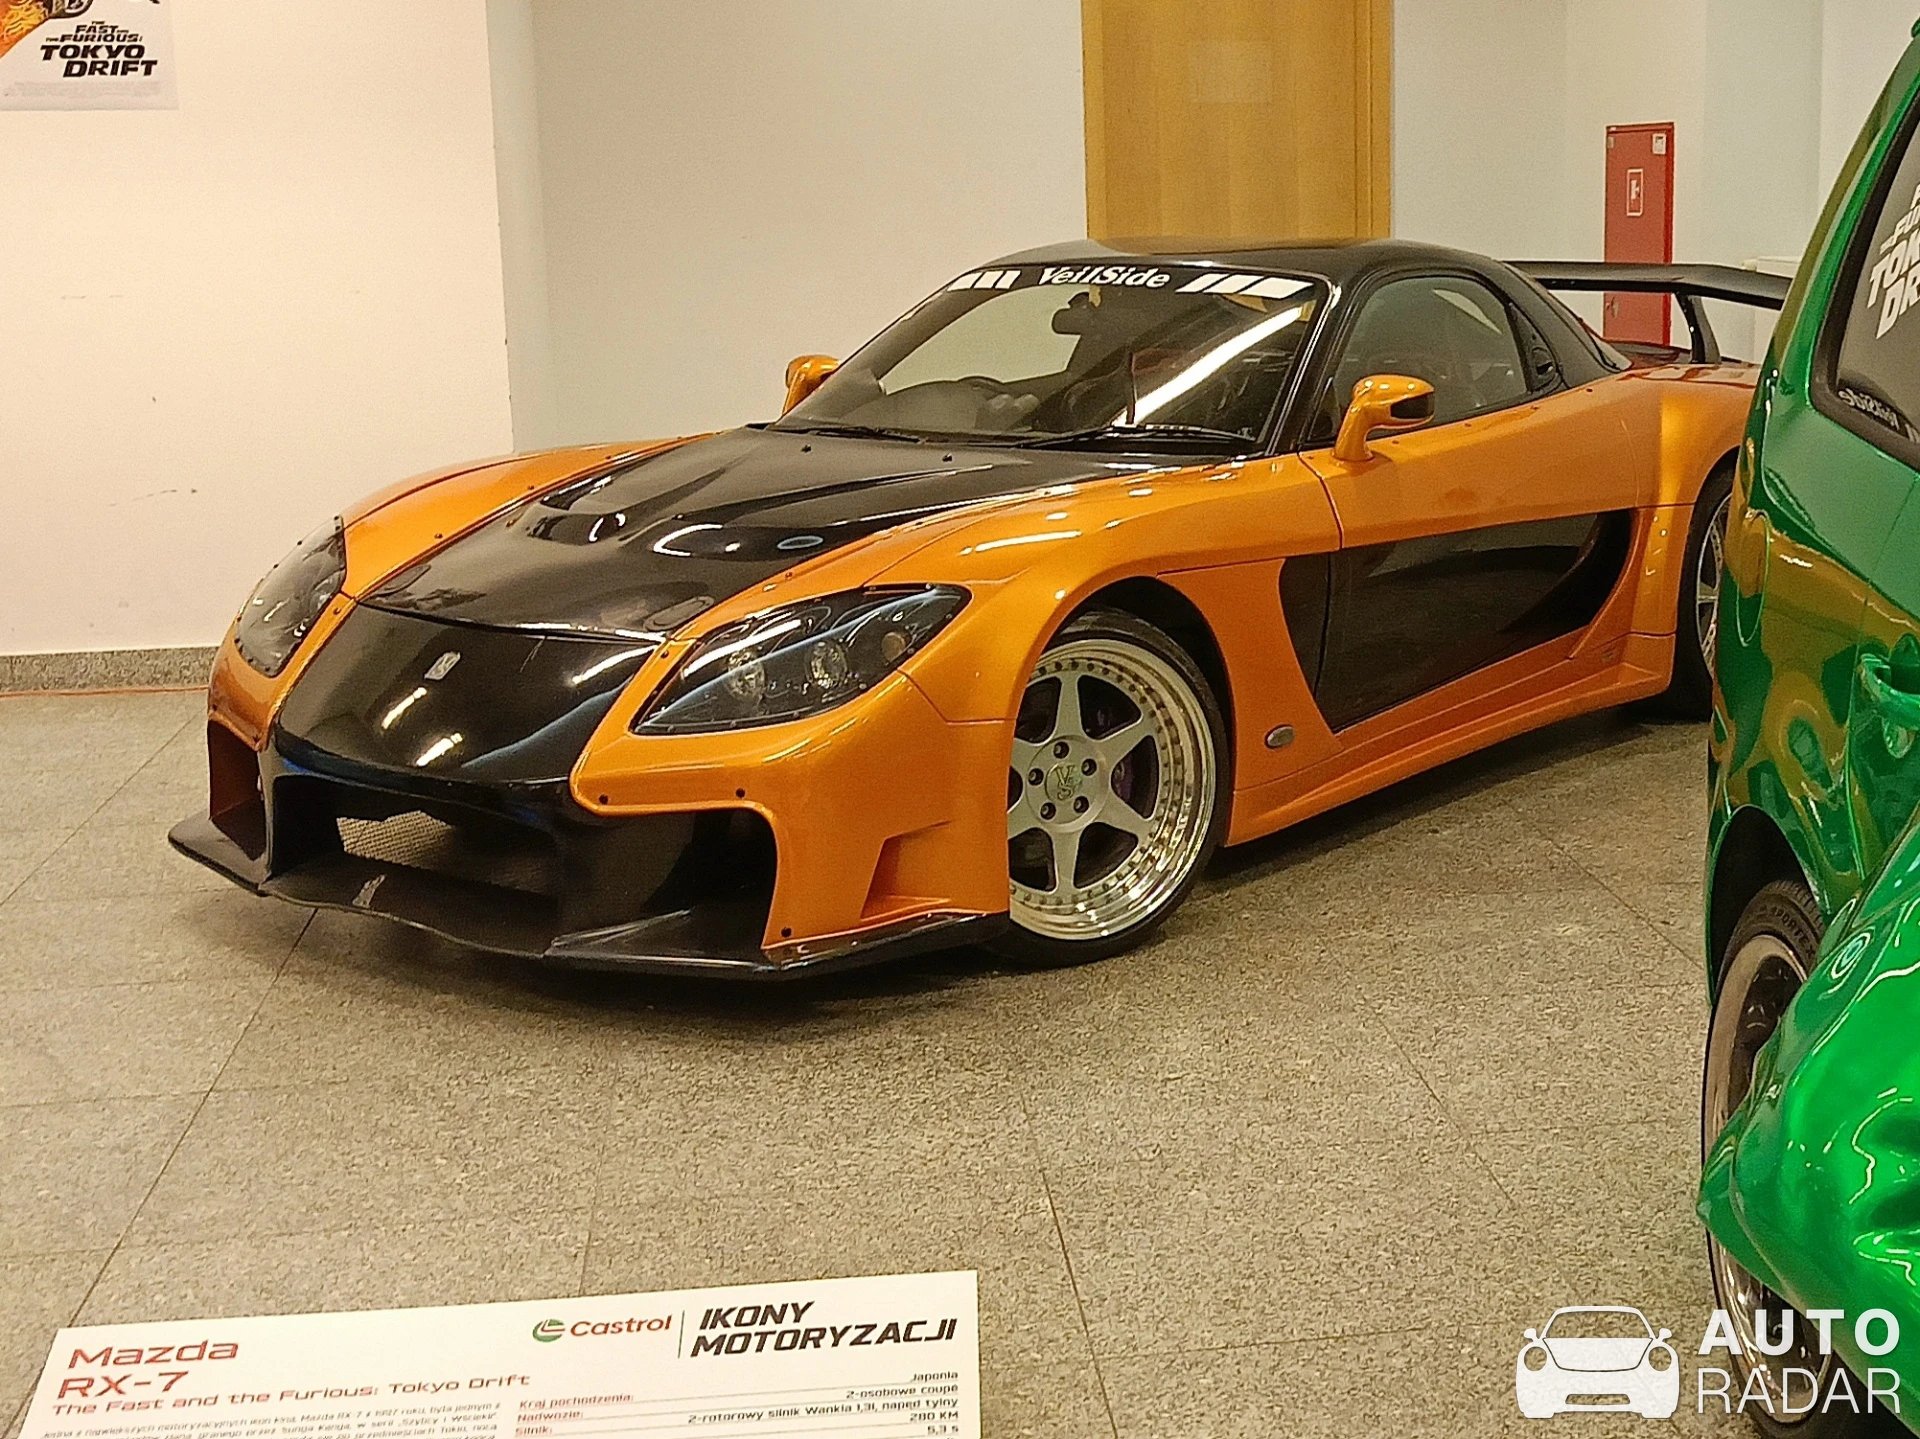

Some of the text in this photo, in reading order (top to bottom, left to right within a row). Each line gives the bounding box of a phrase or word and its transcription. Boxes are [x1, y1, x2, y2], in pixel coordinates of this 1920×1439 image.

[59, 33, 143, 43] FURIOUS:
[75, 25, 118, 34] FAST
[40, 44, 145, 61] TOKYO
[63, 60, 158, 78] DRIFT
[1038, 265, 1171, 289] VeilSide
[698, 1300, 816, 1331] IKONY
[570, 1314, 672, 1338] Castrol
[690, 1317, 958, 1358] MOTORYZACJI
[68, 1339, 239, 1370] Mazda
[56, 1371, 190, 1399] RX-7
[912, 1371, 959, 1383] Japonia
[52, 1374, 531, 1416] The Fast and the Furious: Tokyo Drift
[845, 1387, 917, 1399] 2-osobowe
[688, 1410, 764, 1424] 2-rotorowy
[939, 1411, 959, 1420] KM
